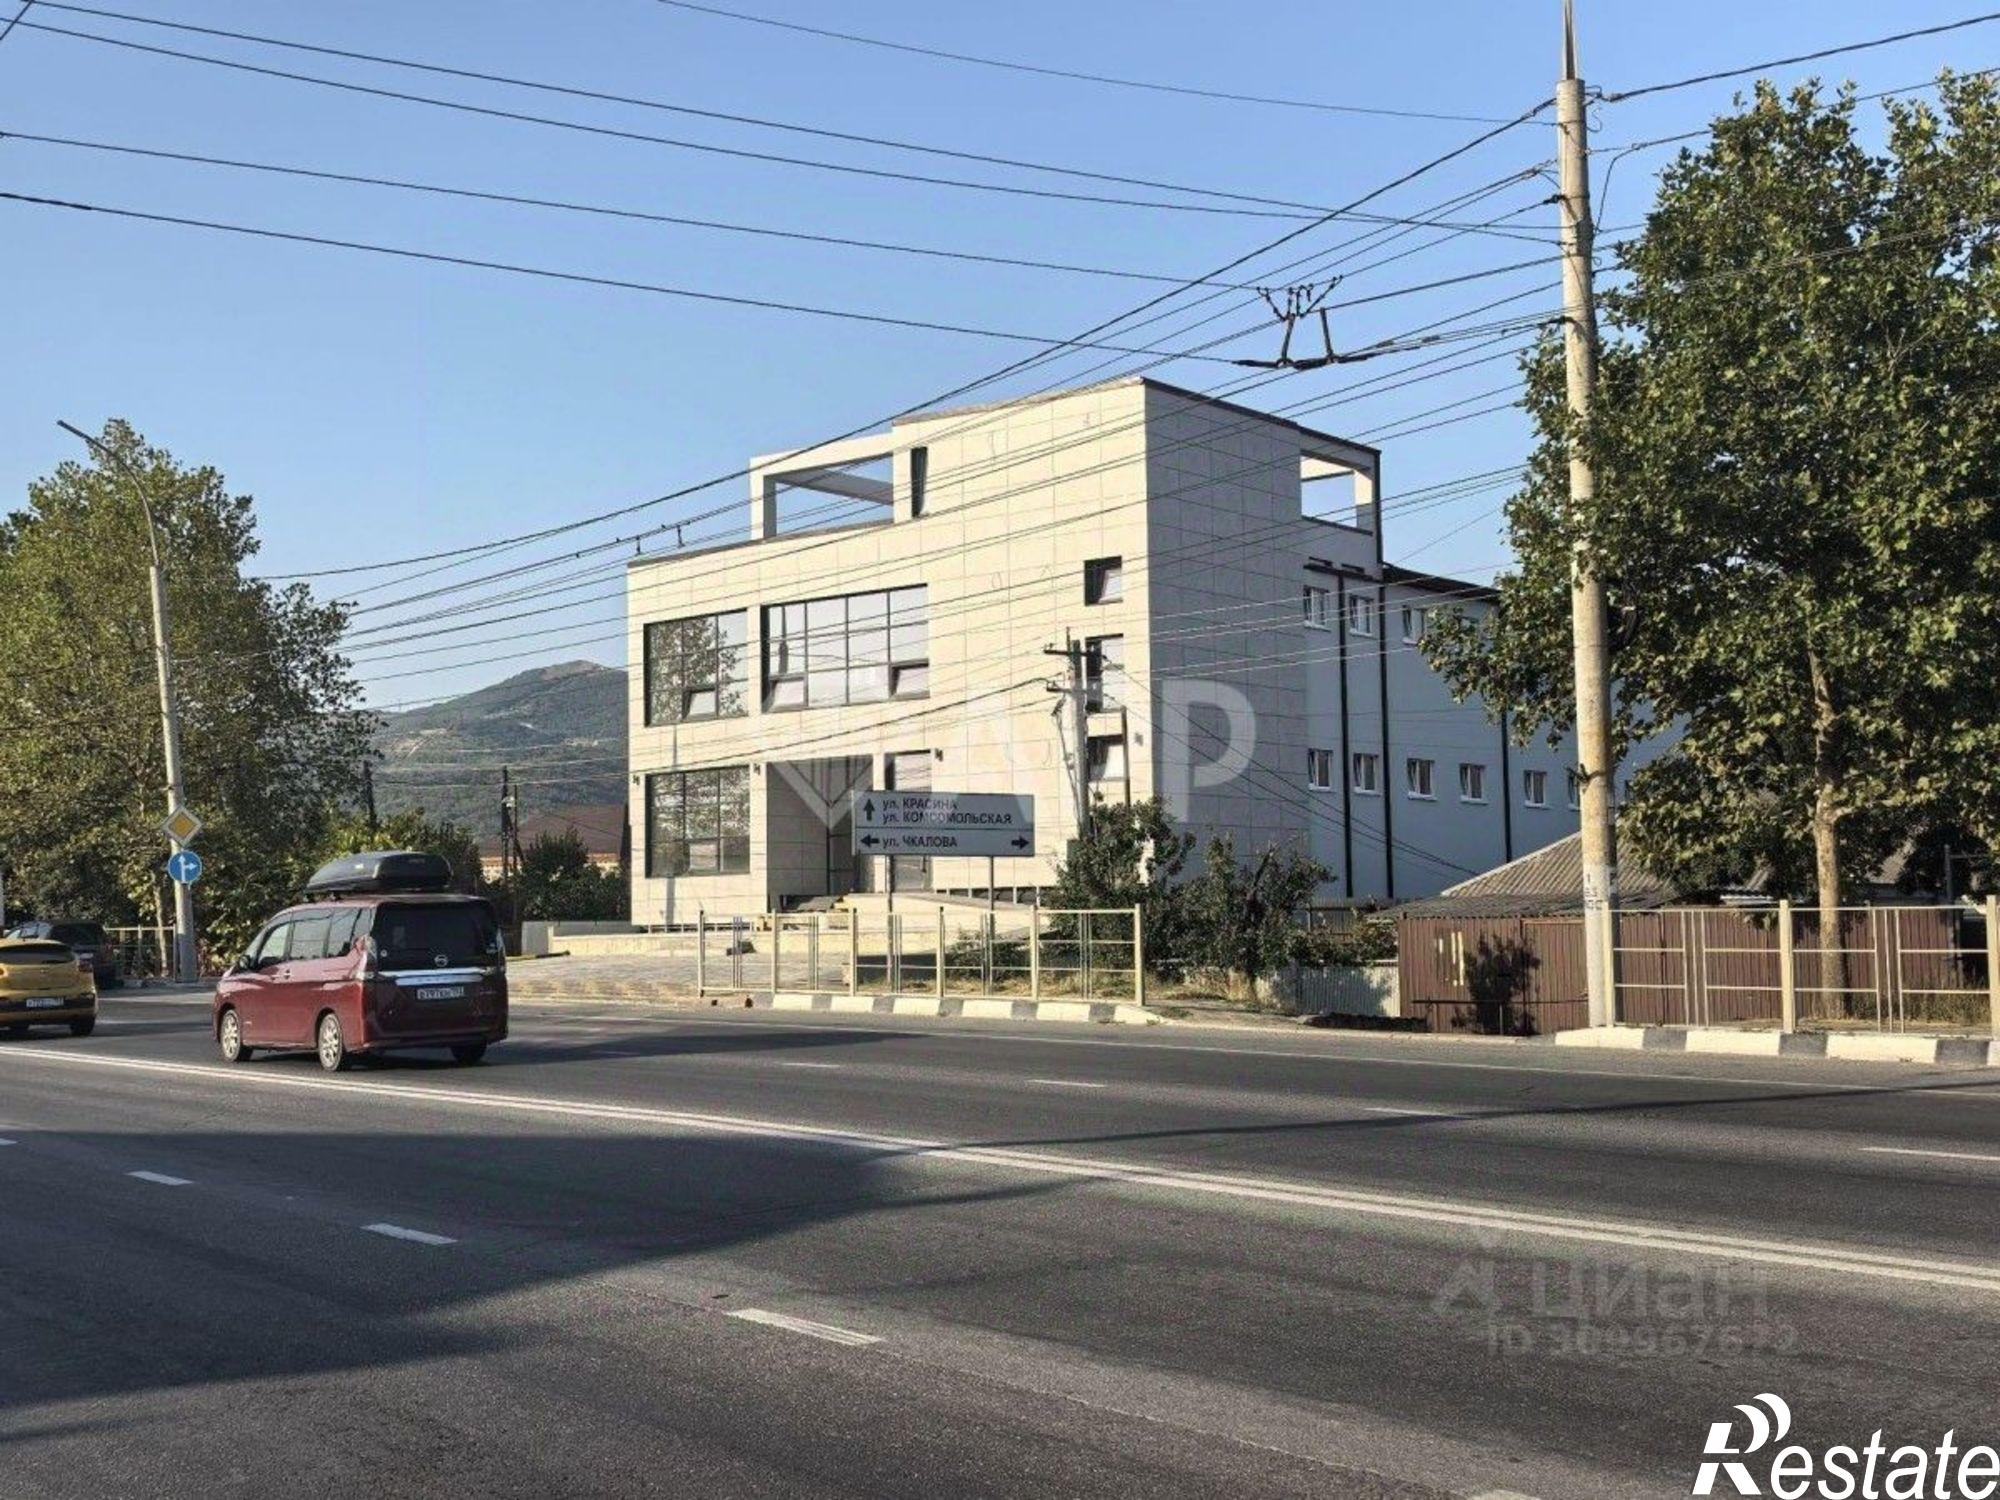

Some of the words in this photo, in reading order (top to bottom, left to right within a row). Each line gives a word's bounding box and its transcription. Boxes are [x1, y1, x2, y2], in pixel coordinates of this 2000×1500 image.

[883, 800, 899, 811] ул.
[883, 813, 899, 825] ул.
[882, 838, 899, 849] ул.
[902, 836, 958, 848] ЧКАЛОВА
